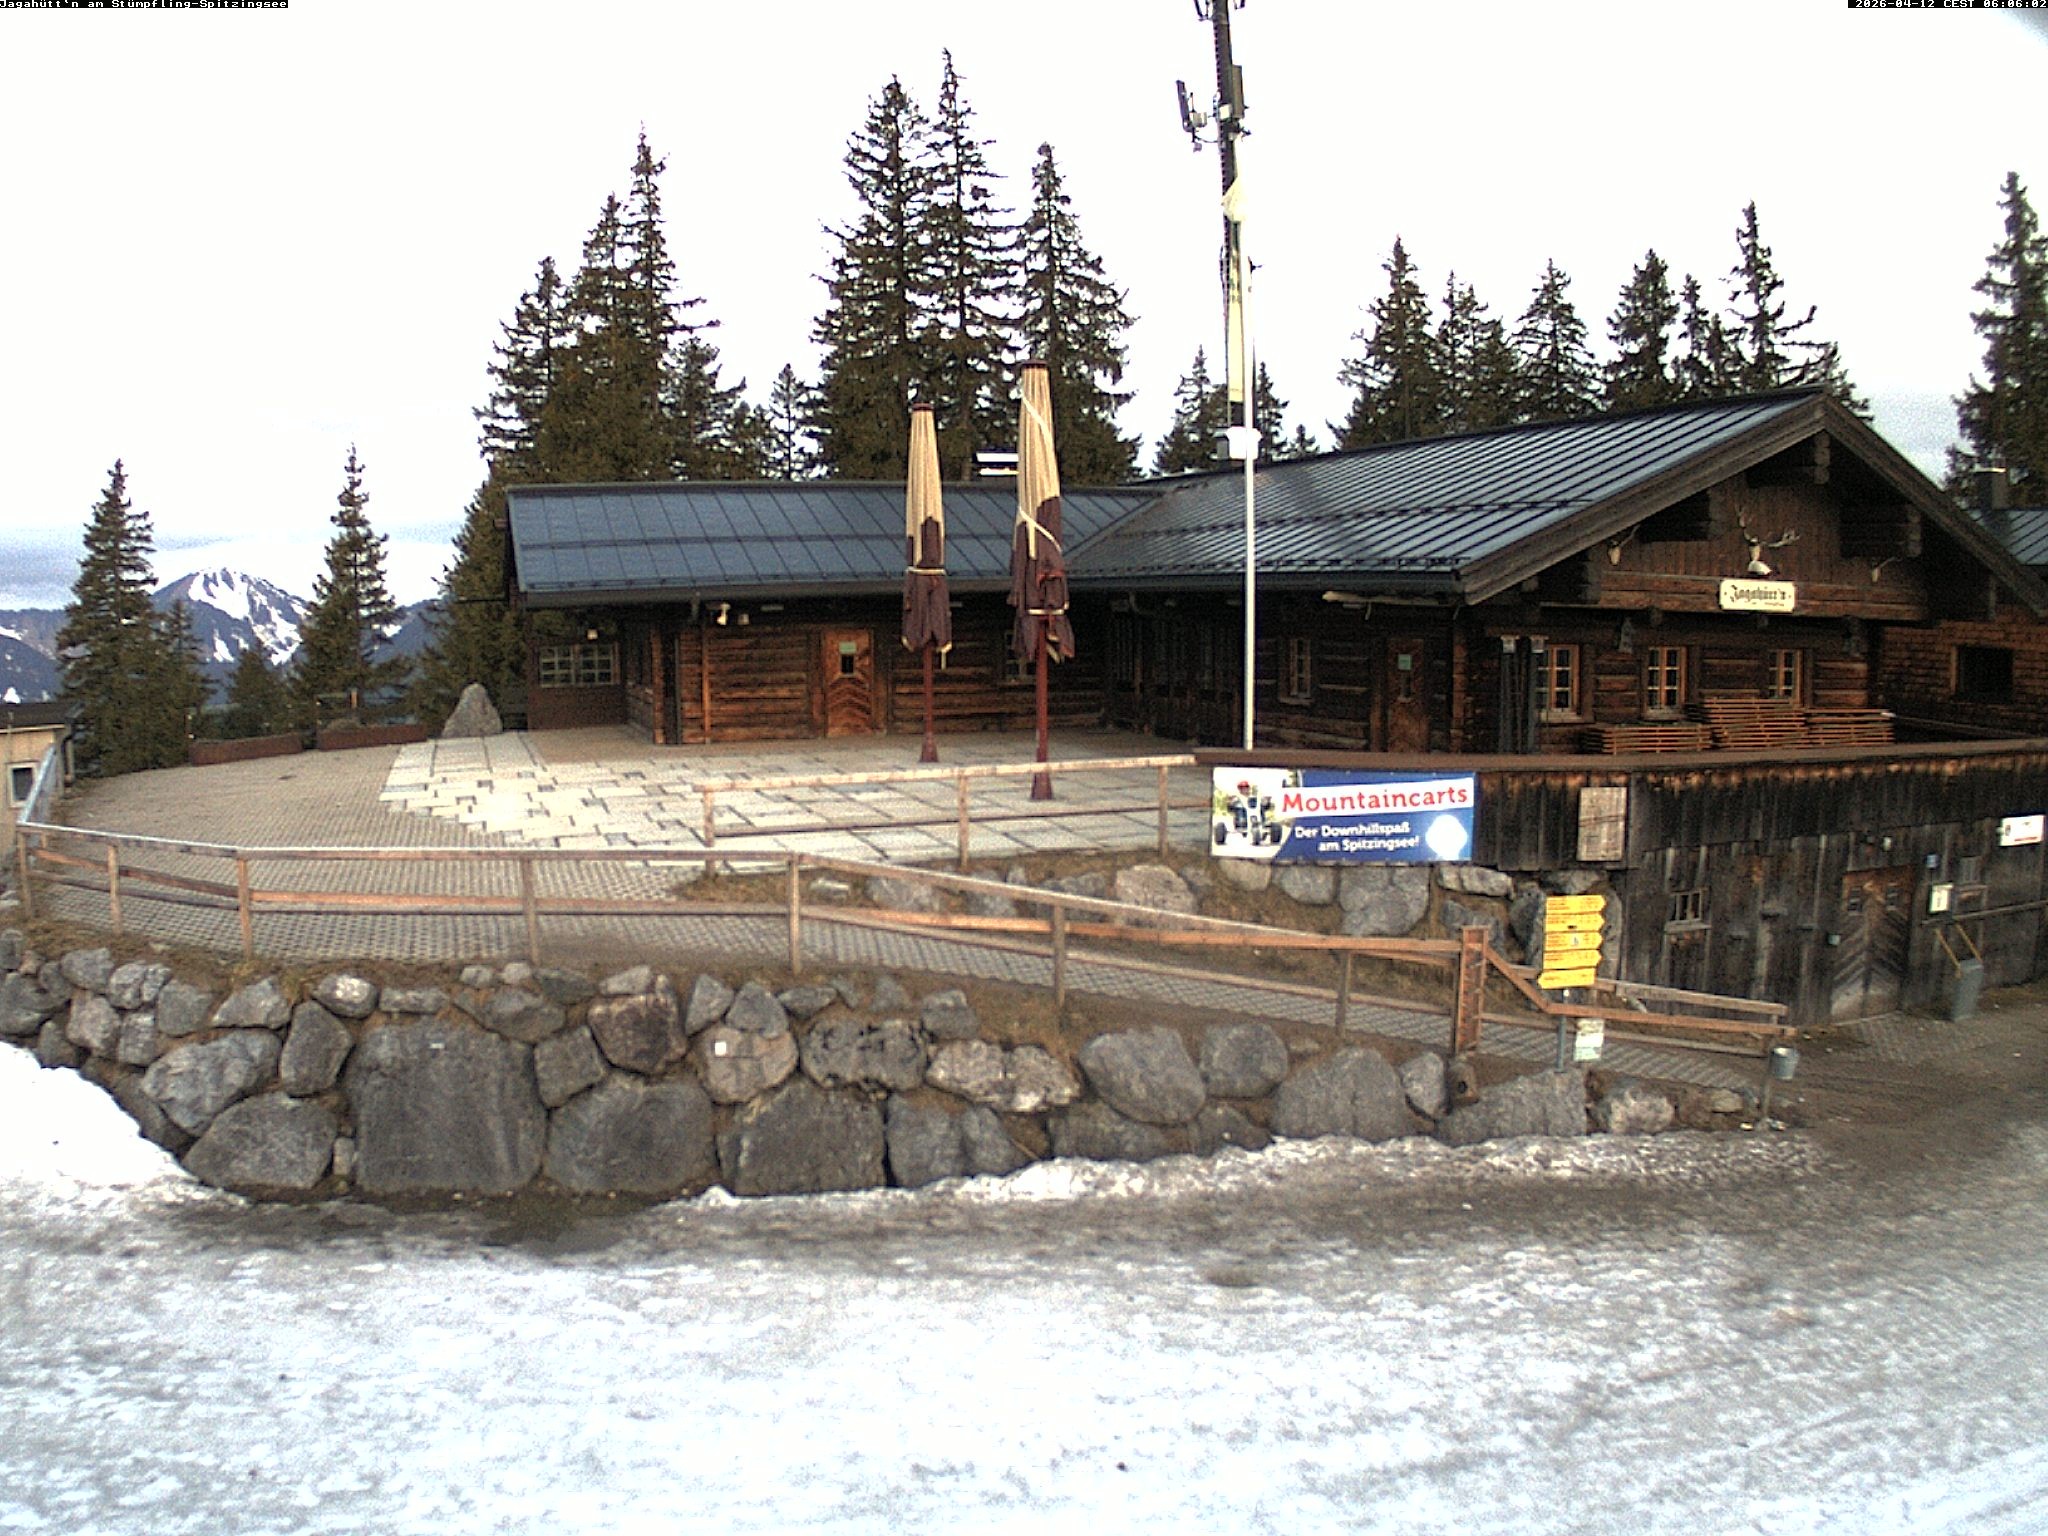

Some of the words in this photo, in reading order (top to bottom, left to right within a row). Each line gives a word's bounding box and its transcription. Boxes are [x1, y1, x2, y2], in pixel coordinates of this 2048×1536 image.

[1282, 786, 1468, 813] Mountaincarts
[1295, 826, 1319, 839] Der
[1321, 821, 1411, 839] Downhillspaß
[1319, 842, 1341, 852] am
[1342, 835, 1420, 853] Spitzingsee!
